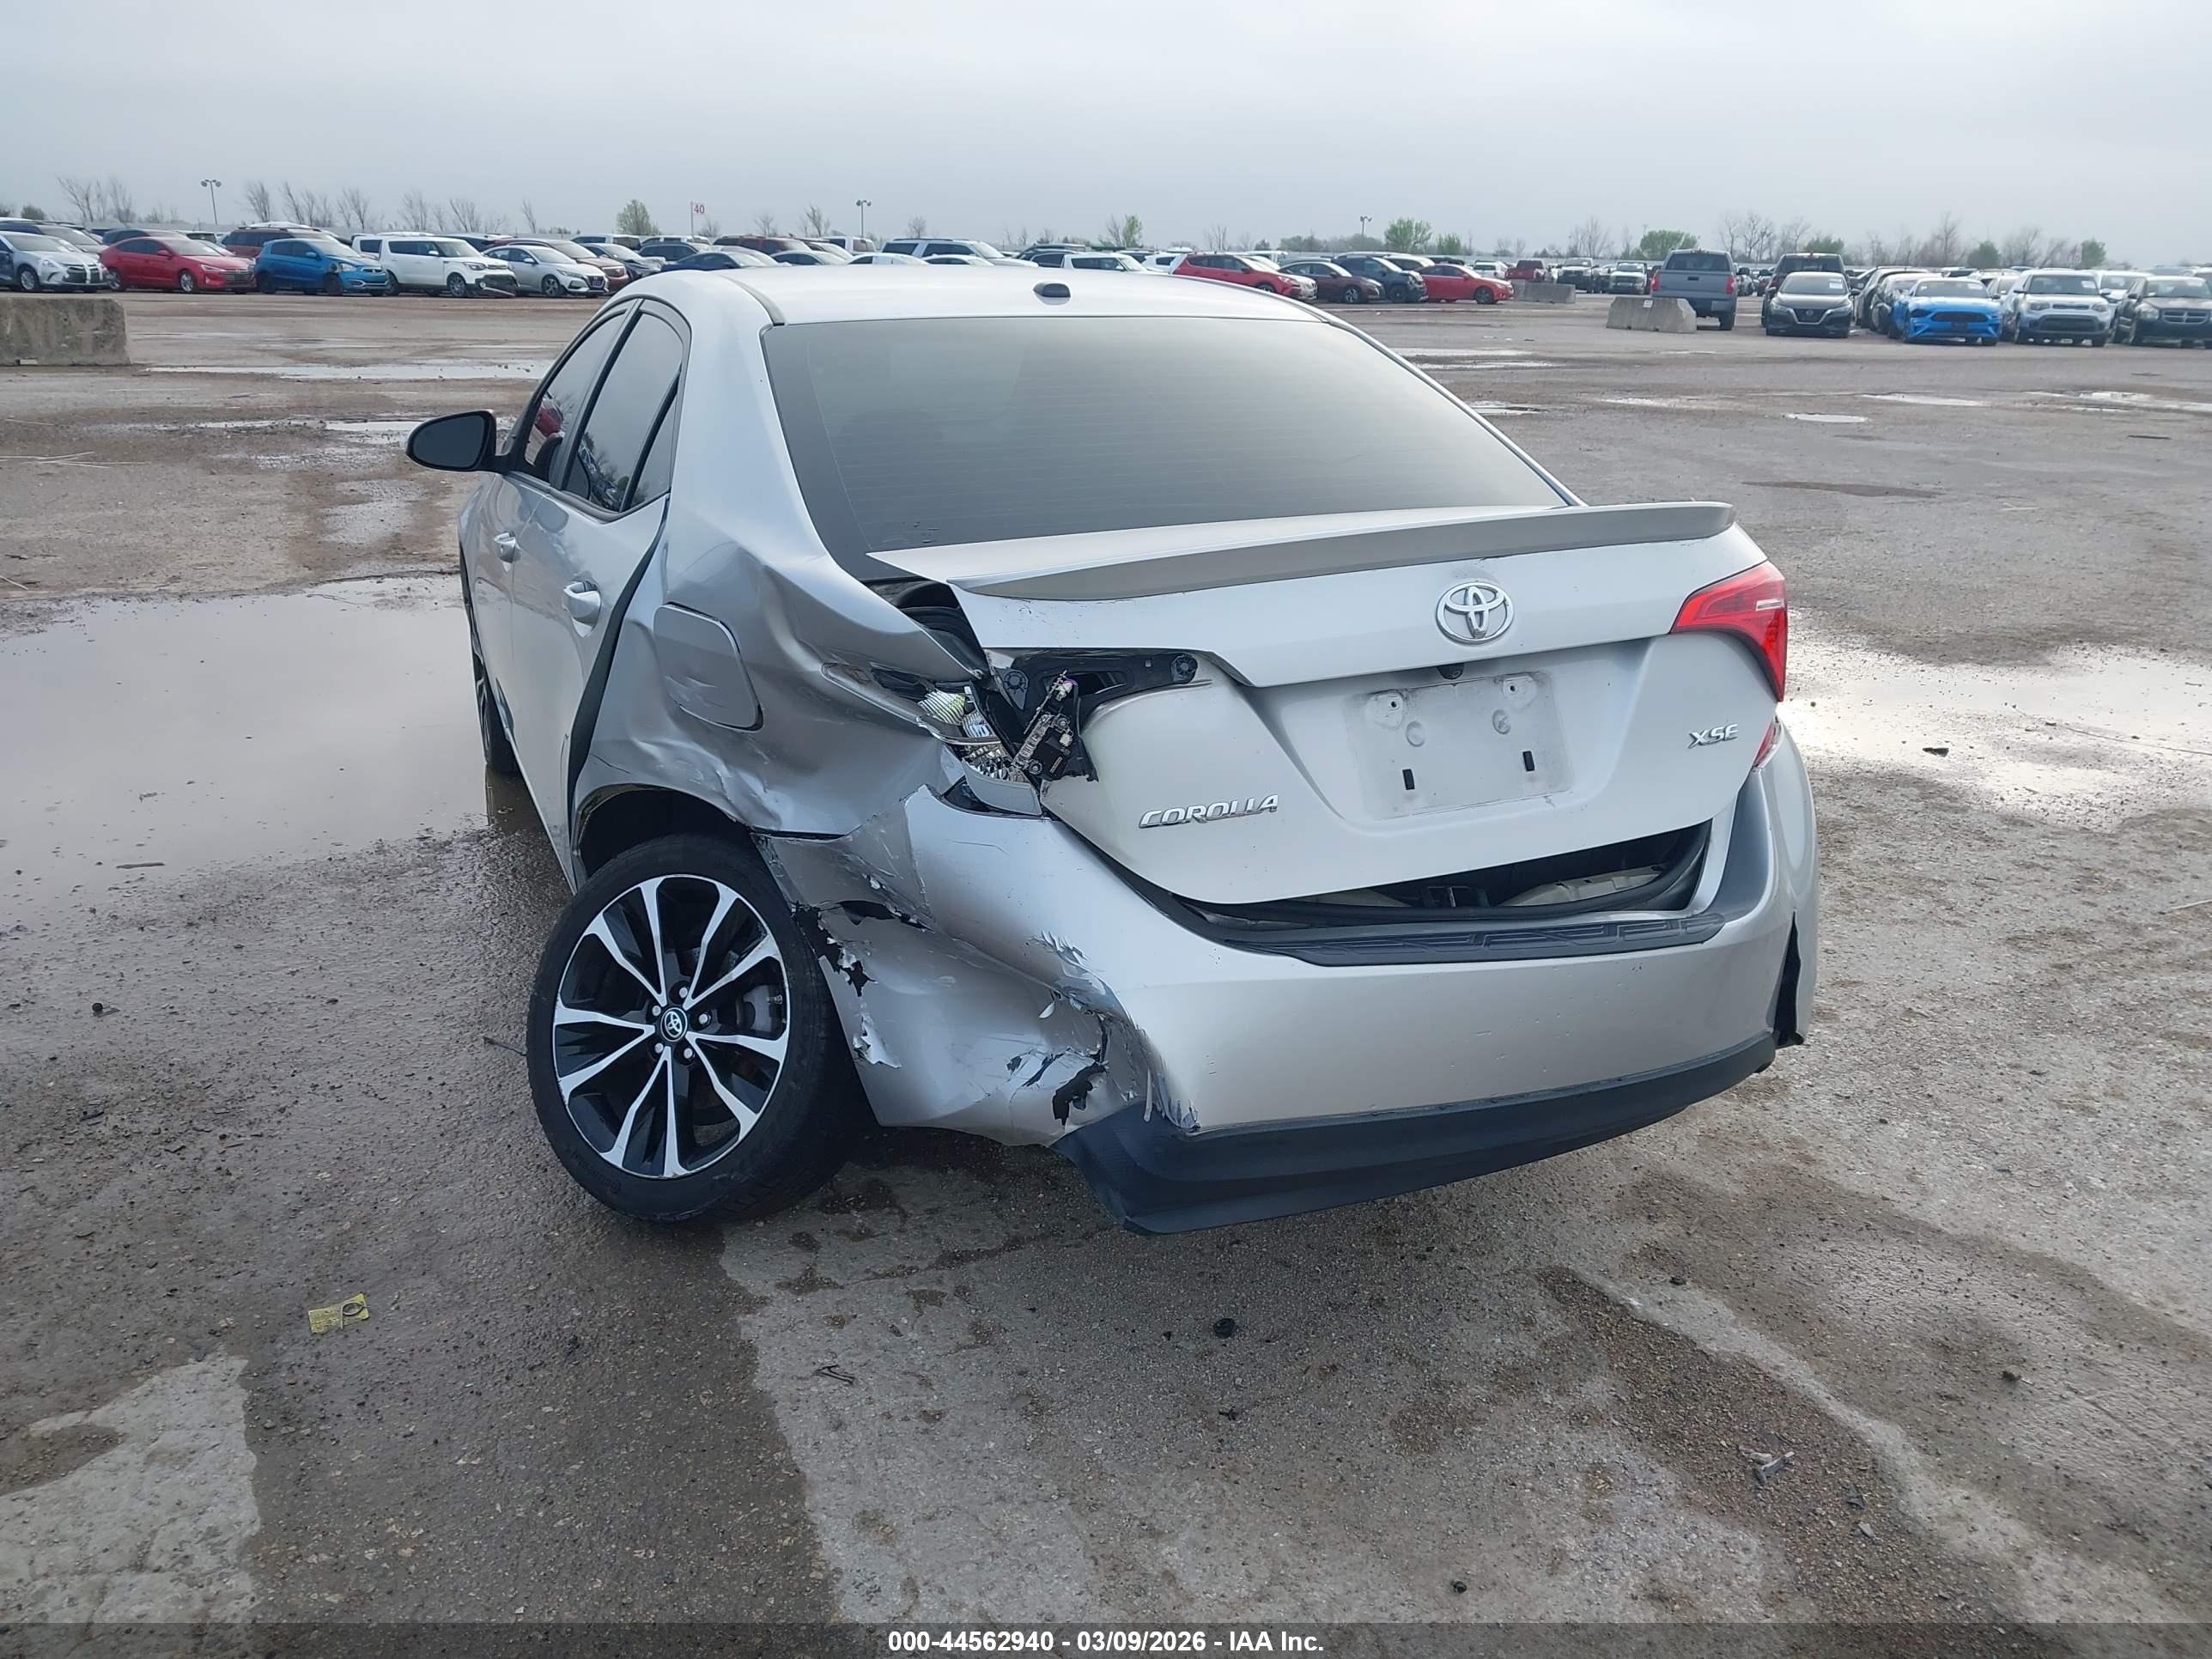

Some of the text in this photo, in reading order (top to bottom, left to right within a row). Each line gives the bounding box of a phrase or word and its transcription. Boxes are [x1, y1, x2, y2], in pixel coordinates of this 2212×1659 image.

[694, 204, 705, 214] 40
[1688, 724, 1738, 749] XSE
[1139, 794, 1279, 829] COROLLA
